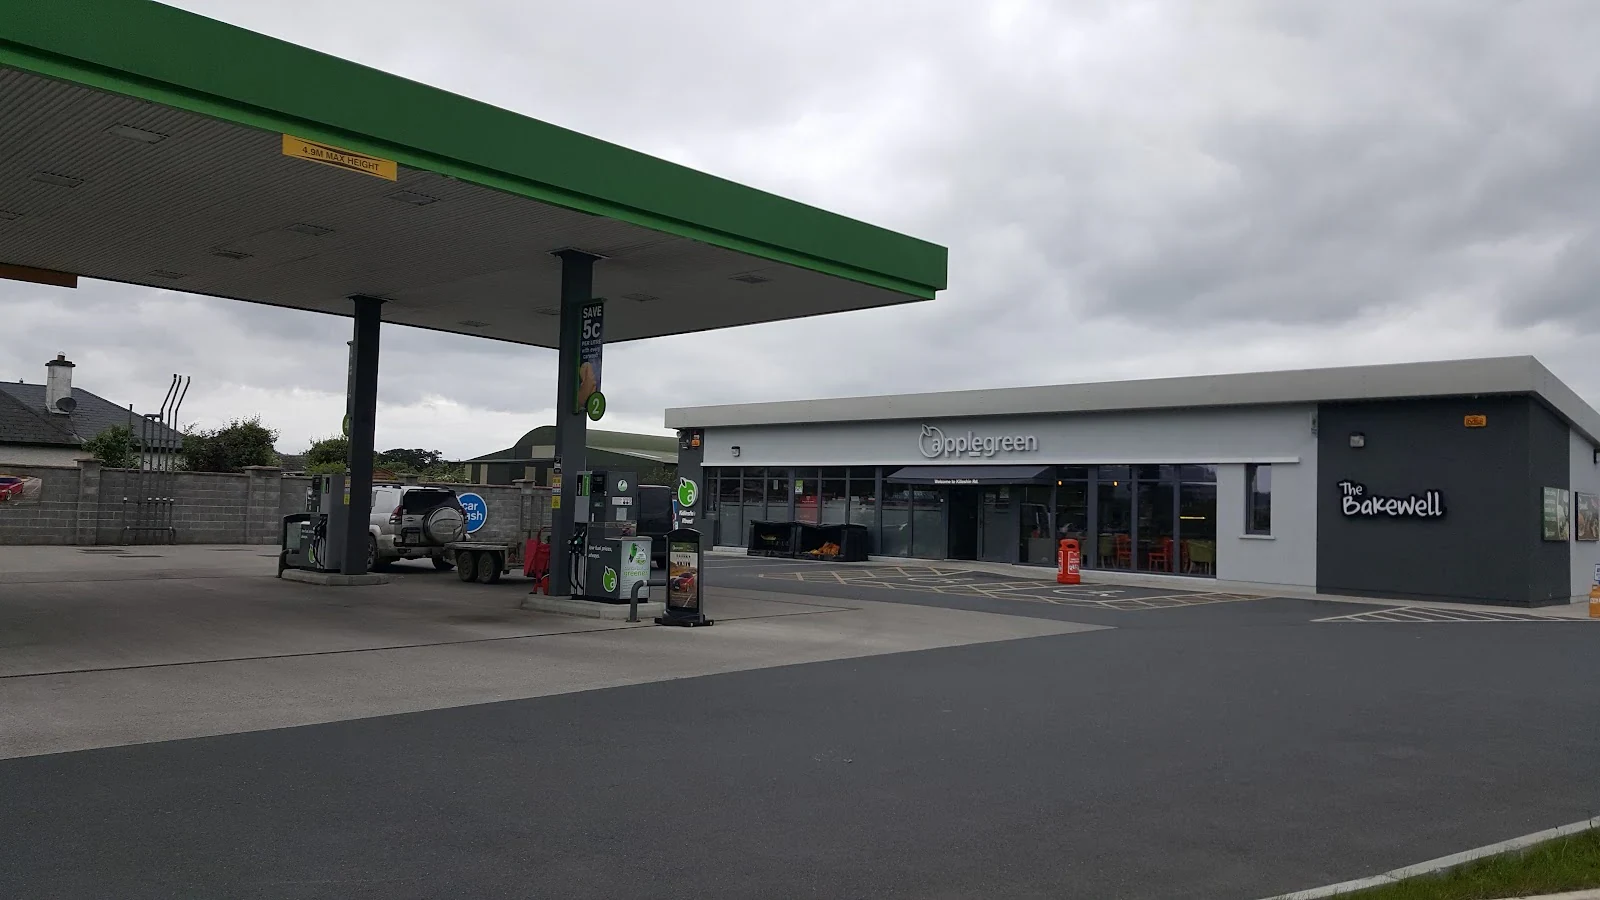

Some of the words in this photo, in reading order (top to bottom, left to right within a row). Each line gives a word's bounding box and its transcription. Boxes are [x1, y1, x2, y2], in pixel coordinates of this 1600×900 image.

[302, 146, 323, 157] 4.9M
[326, 152, 345, 163] MAX
[347, 157, 380, 171] HEIGHT
[583, 305, 602, 319] SAVE
[582, 319, 601, 339] 5c
[592, 398, 600, 414] 2
[928, 430, 1038, 457] applegreen
[1339, 482, 1363, 495] The
[463, 502, 478, 511] car
[1342, 491, 1443, 516] Bakewell
[466, 511, 483, 520] ash
